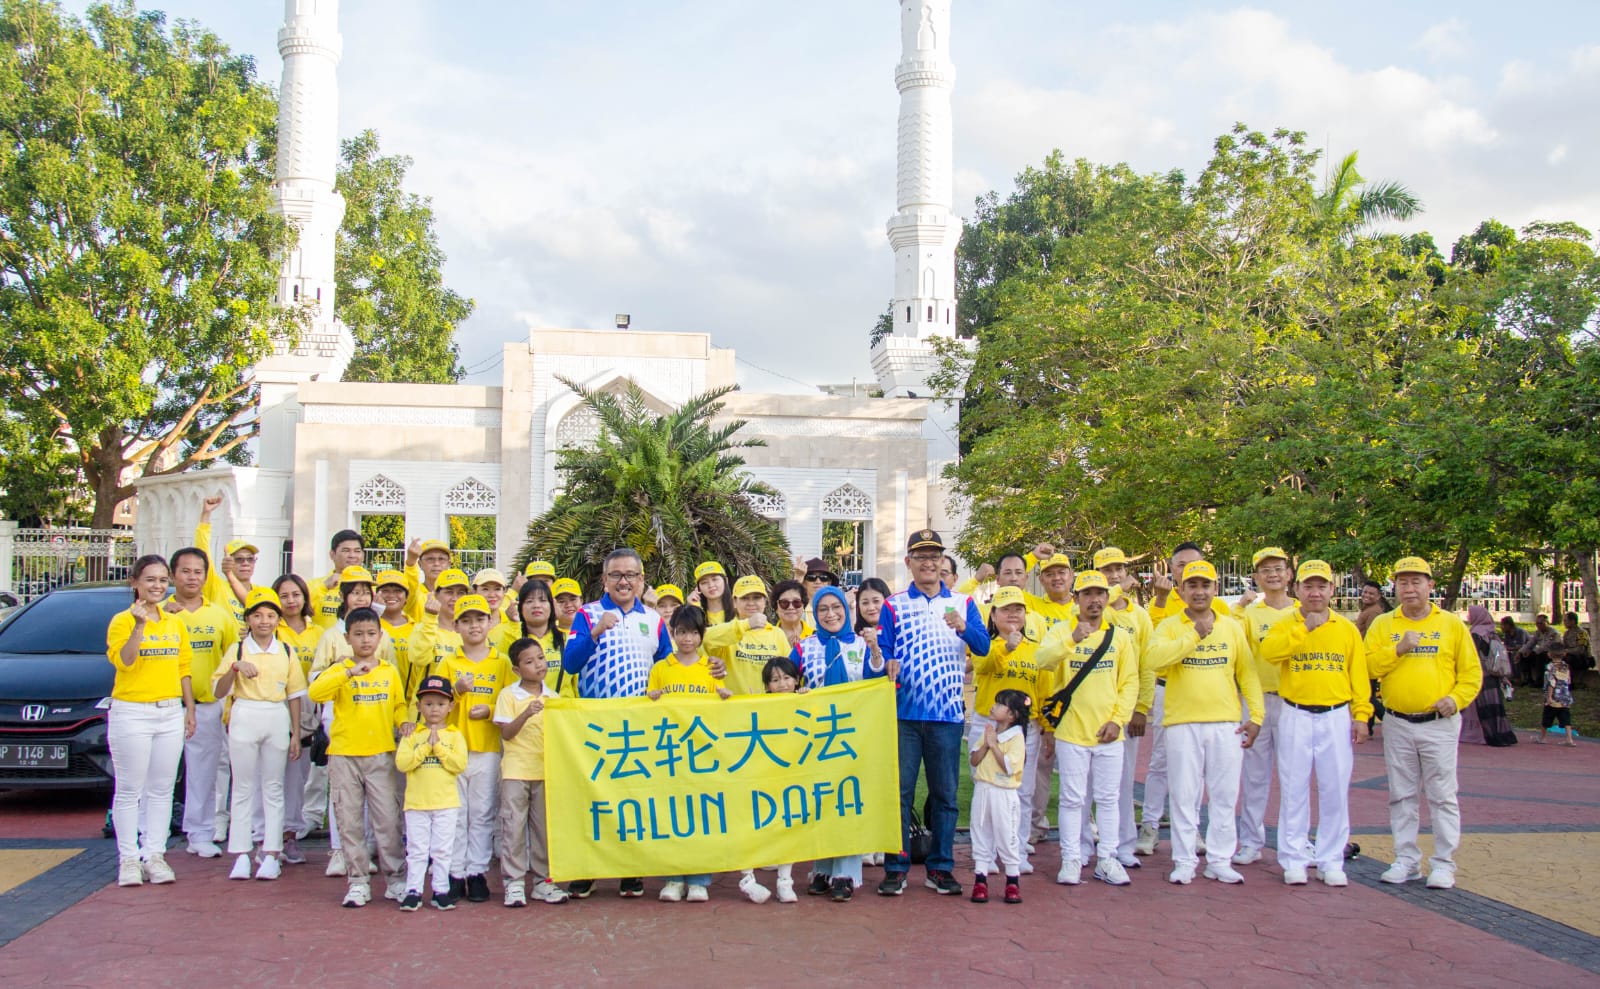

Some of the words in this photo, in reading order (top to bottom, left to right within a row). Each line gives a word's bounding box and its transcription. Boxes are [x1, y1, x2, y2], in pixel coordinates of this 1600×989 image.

[1183, 658, 1206, 667] FALUN
[1208, 657, 1227, 666] DAFA
[1309, 653, 1324, 661] DAFA
[1331, 653, 1345, 662] GOOD
[584, 703, 859, 782] 法轮大法
[17, 746, 45, 760] 1148
[49, 746, 67, 760] JG
[589, 790, 728, 842] FALUN
[751, 775, 864, 830] DAFA
